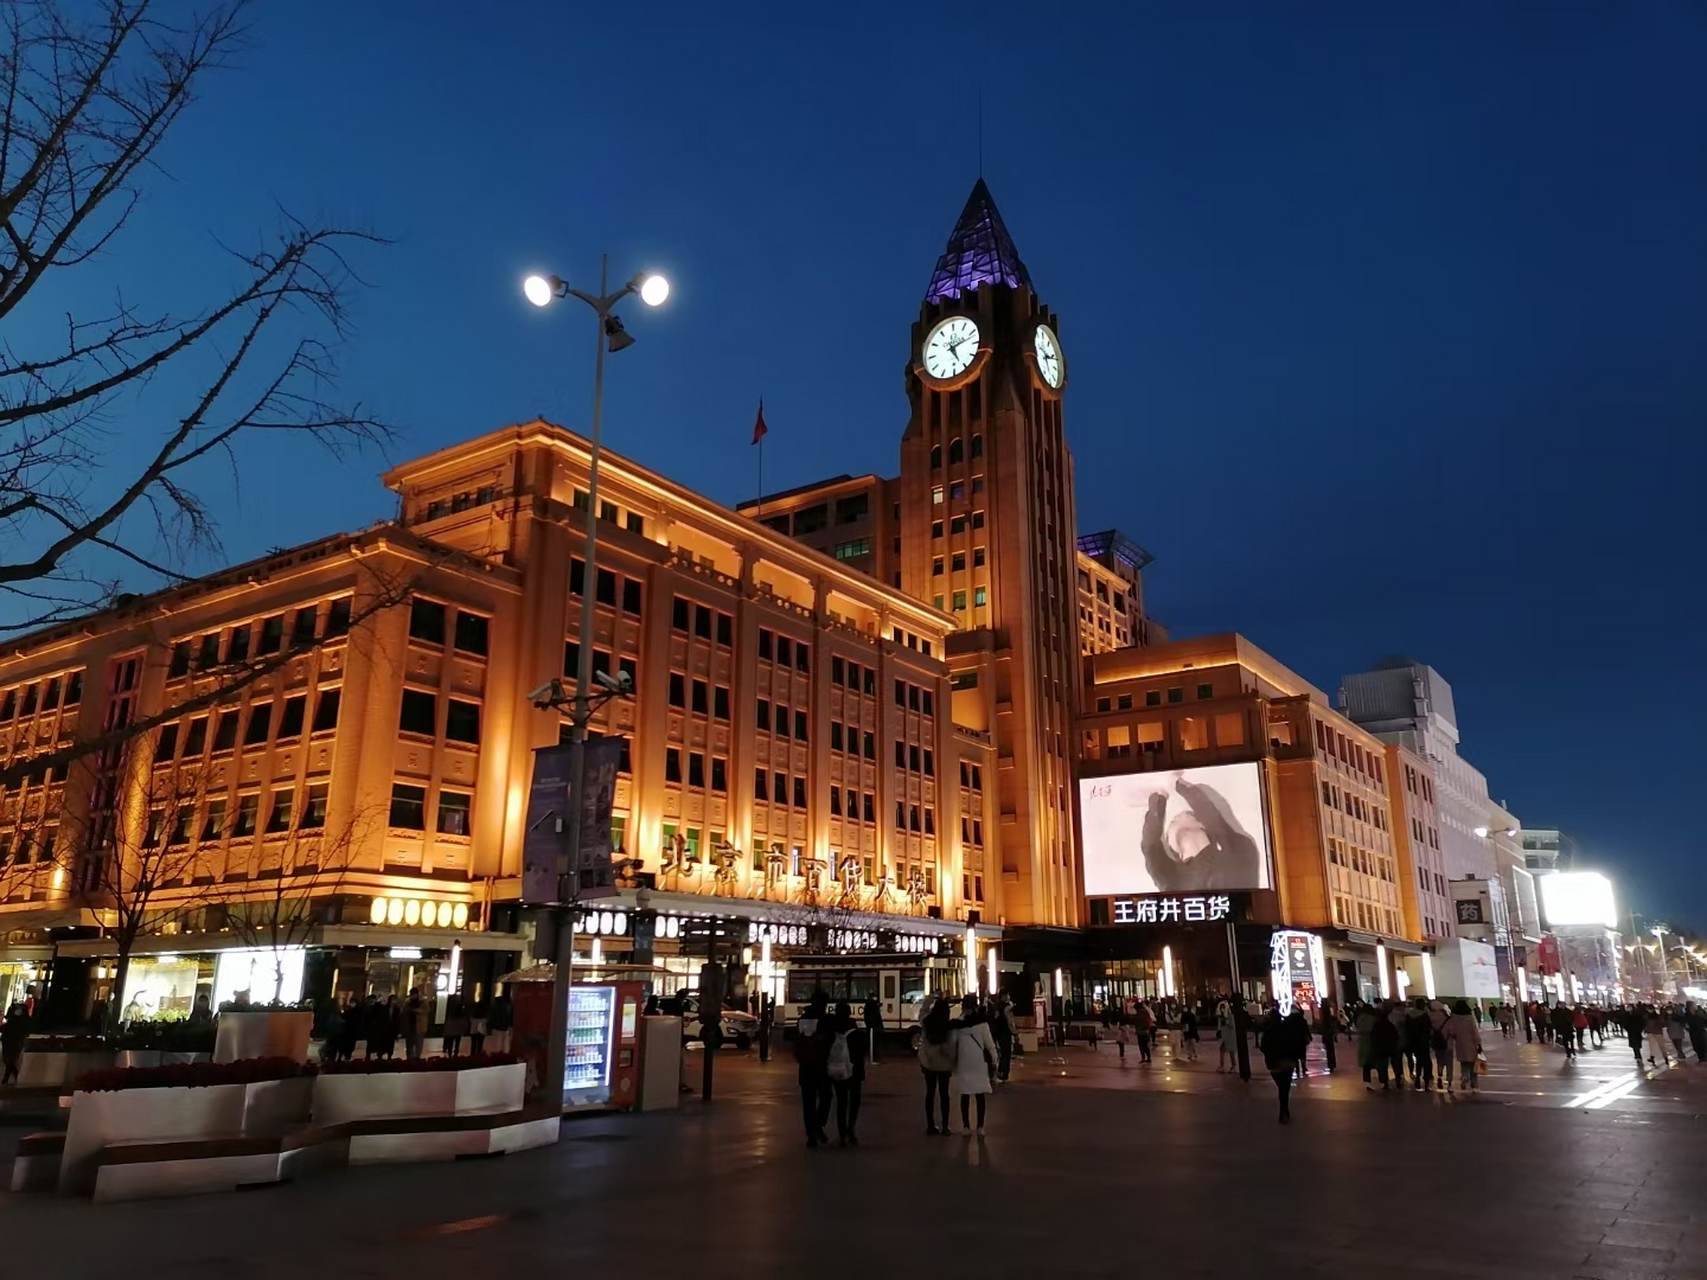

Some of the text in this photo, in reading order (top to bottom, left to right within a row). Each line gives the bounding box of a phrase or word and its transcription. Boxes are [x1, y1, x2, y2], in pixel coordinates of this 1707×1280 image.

[661, 834, 929, 908] 北京市百货大楼
[1114, 895, 1230, 923] 王府井百货
[1459, 903, 1479, 921] 药
